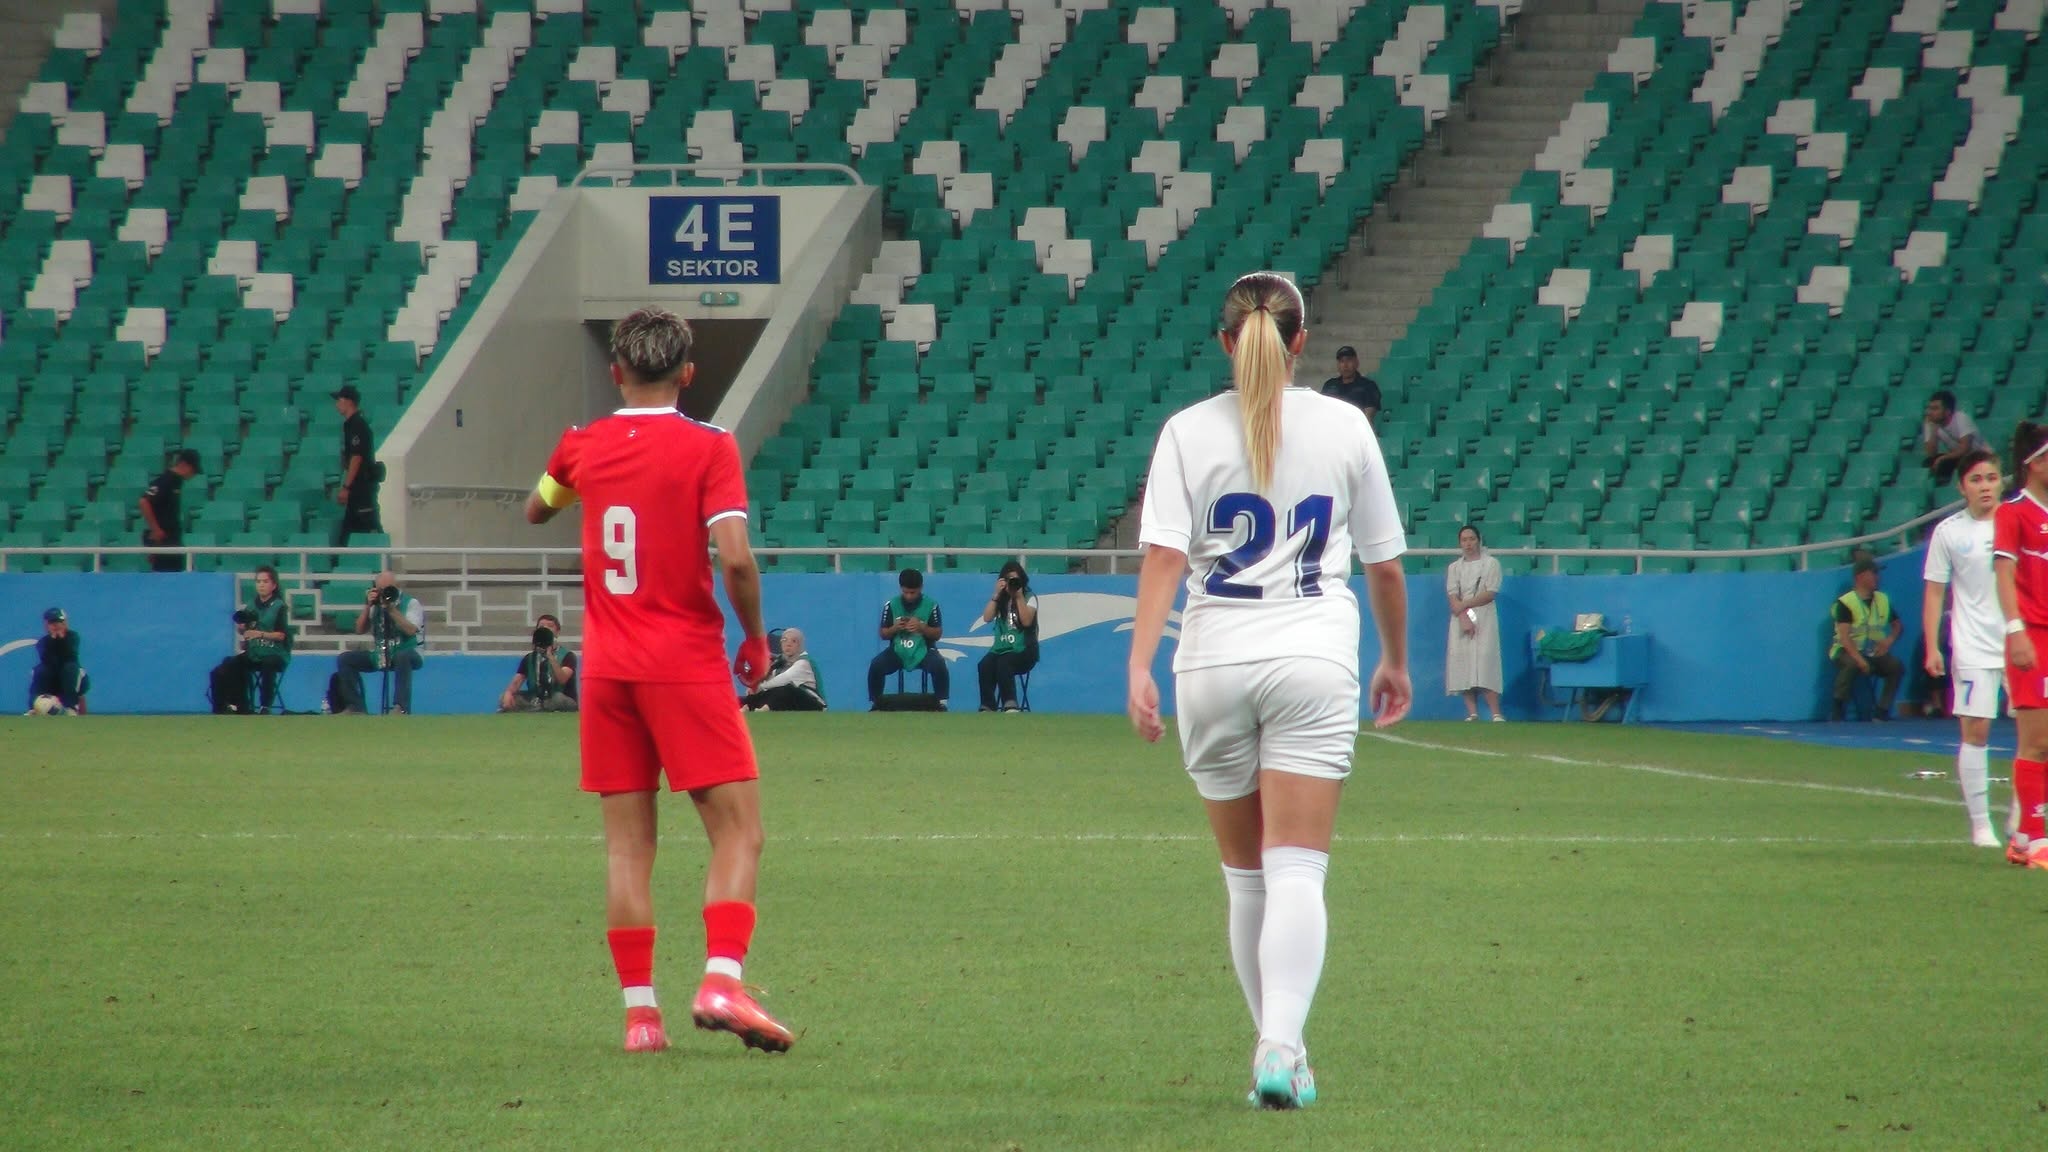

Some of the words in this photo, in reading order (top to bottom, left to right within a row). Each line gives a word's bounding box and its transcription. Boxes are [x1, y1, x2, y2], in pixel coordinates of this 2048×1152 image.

[667, 259, 759, 277] SEKTOR
[603, 505, 638, 595] 9
[1202, 492, 1334, 600] 21
[1961, 680, 1975, 706] 7
